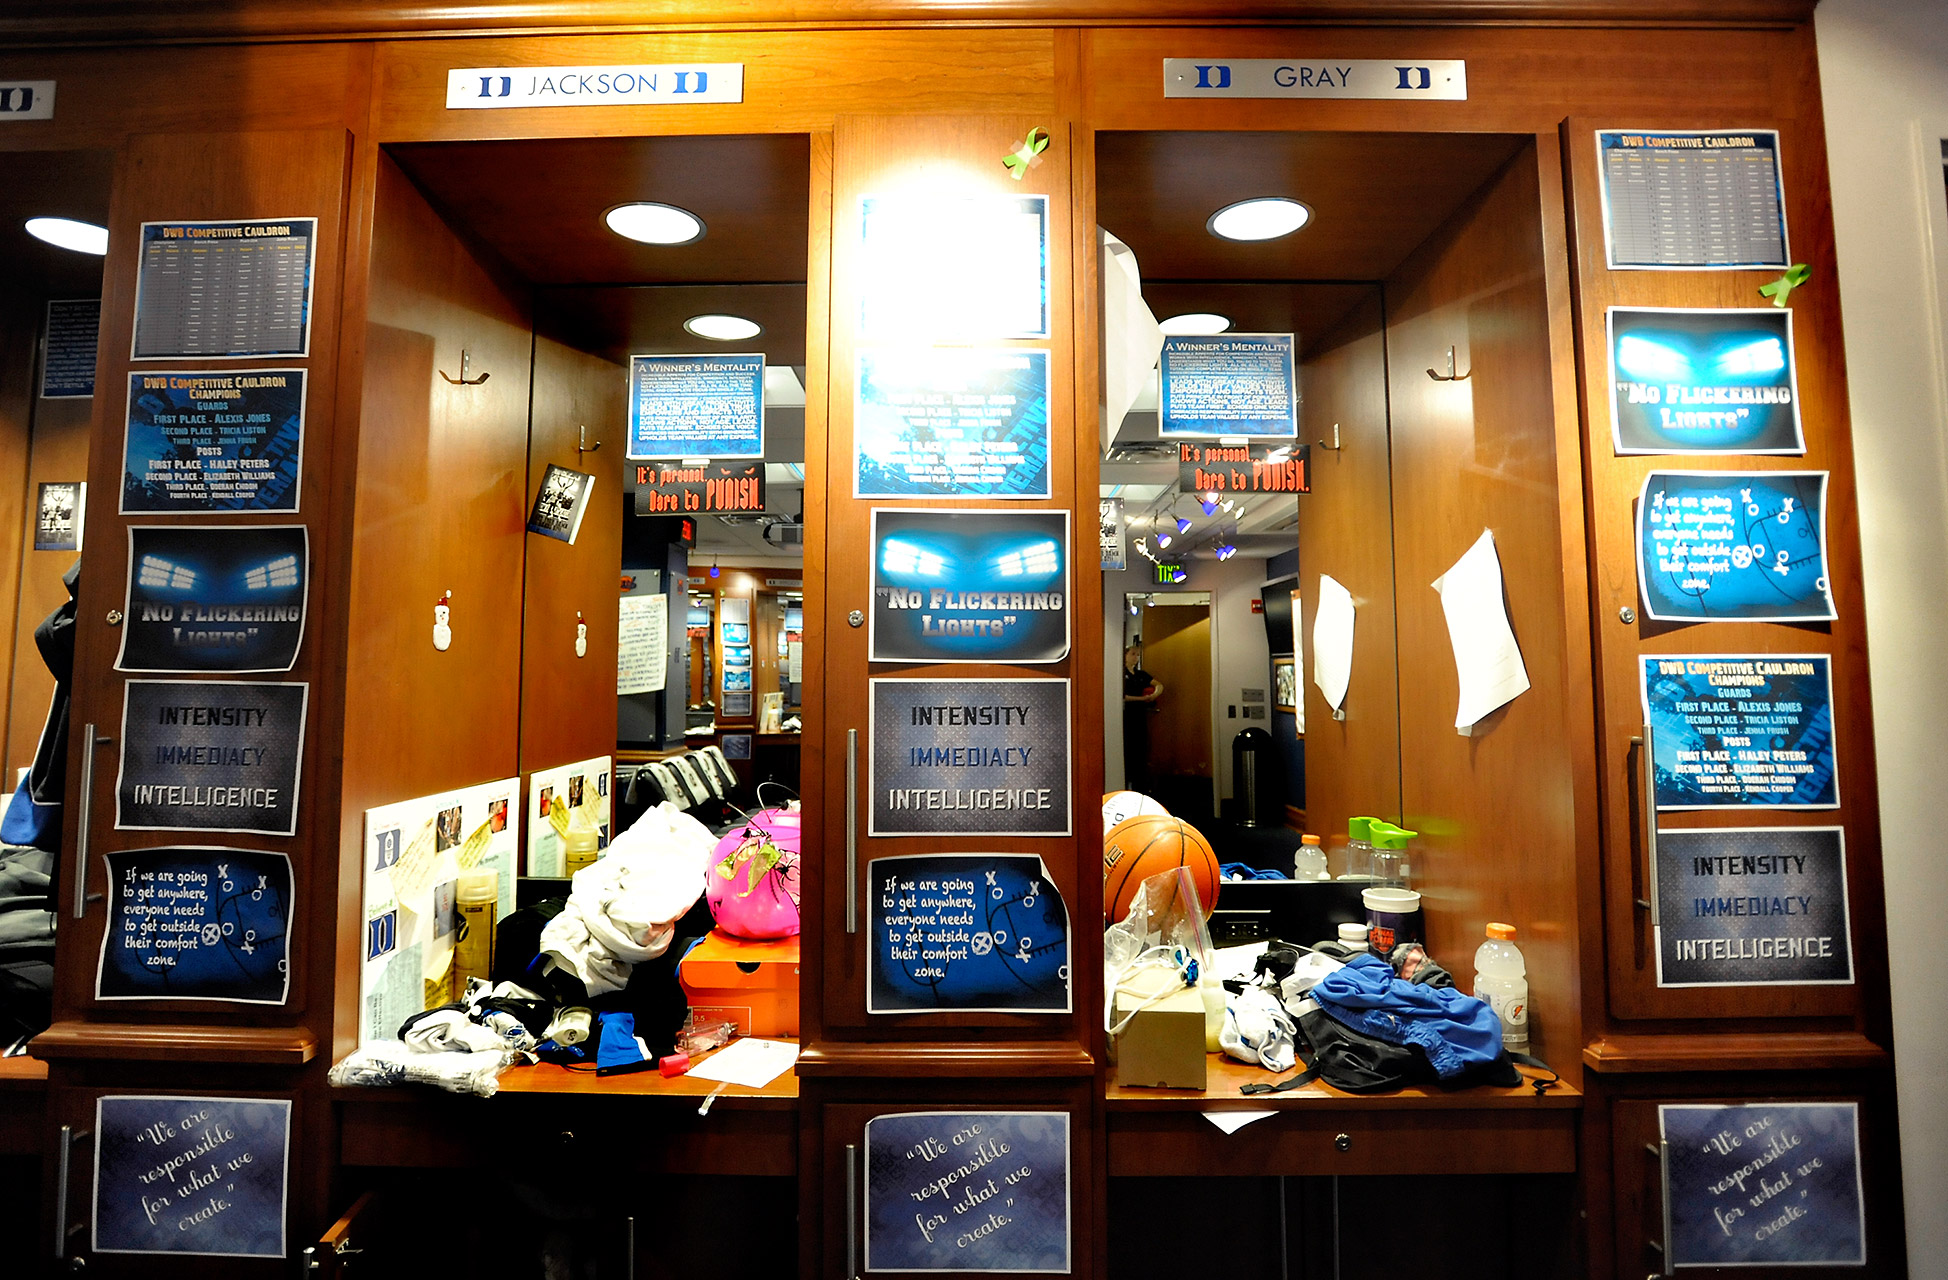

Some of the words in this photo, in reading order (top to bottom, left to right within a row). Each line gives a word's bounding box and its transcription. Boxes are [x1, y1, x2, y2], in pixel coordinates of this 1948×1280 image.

[529, 74, 657, 95] JACKSON
[1274, 66, 1351, 87] GRAY
[160, 707, 268, 726] INTENSITY
[912, 706, 1029, 726] INTENSITY
[156, 746, 265, 766] IMMEDIACY
[910, 747, 1032, 767] IMMEDIACY
[134, 785, 278, 808] INTELLIGENCE
[890, 789, 1051, 810] INTELLIGENCE
[126, 867, 136, 883] If
[141, 873, 154, 881] we
[158, 872, 173, 881] are
[177, 871, 207, 884] going
[1694, 855, 1806, 876] INTENSITY
[124, 885, 134, 897] to
[138, 886, 154, 902] get
[158, 886, 208, 905] anywhere,
[885, 876, 896, 894] If
[901, 881, 915, 890] we
[920, 881, 937, 891] are
[942, 879, 974, 894] going
[124, 906, 170, 921] everyone
[173, 903, 204, 915] needs
[883, 895, 894, 907] to
[899, 897, 916, 912] get
[921, 895, 976, 914] anywhere,
[1694, 896, 1811, 917] IMMEDIACY
[125, 920, 136, 931] to
[141, 921, 157, 935] get
[161, 920, 200, 932] outside
[885, 916, 936, 931] everyone
[940, 912, 973, 925] needs
[125, 936, 151, 948] their
[155, 934, 198, 951] comfort
[889, 930, 900, 942] to
[906, 931, 922, 946] get
[928, 930, 969, 943] outside
[891, 947, 917, 959] their
[923, 945, 967, 963] comfort
[1677, 937, 1833, 961] INTELLIGENCE
[147, 956, 176, 965] zone.
[914, 967, 945, 977] zone.
[181, 1110, 209, 1130] are
[1745, 1116, 1773, 1139] are
[953, 1124, 982, 1146] are
[139, 1124, 234, 1184] responsible
[1708, 1130, 1801, 1195] responsible
[911, 1138, 1010, 1202] responsible
[142, 1196, 171, 1225] for
[177, 1164, 221, 1197] what
[227, 1152, 253, 1170] we
[1714, 1207, 1745, 1236] for
[1750, 1171, 1793, 1207] what
[1797, 1157, 1823, 1176] we
[916, 1214, 947, 1243] for
[953, 1179, 999, 1214] what
[1005, 1166, 1031, 1185] we
